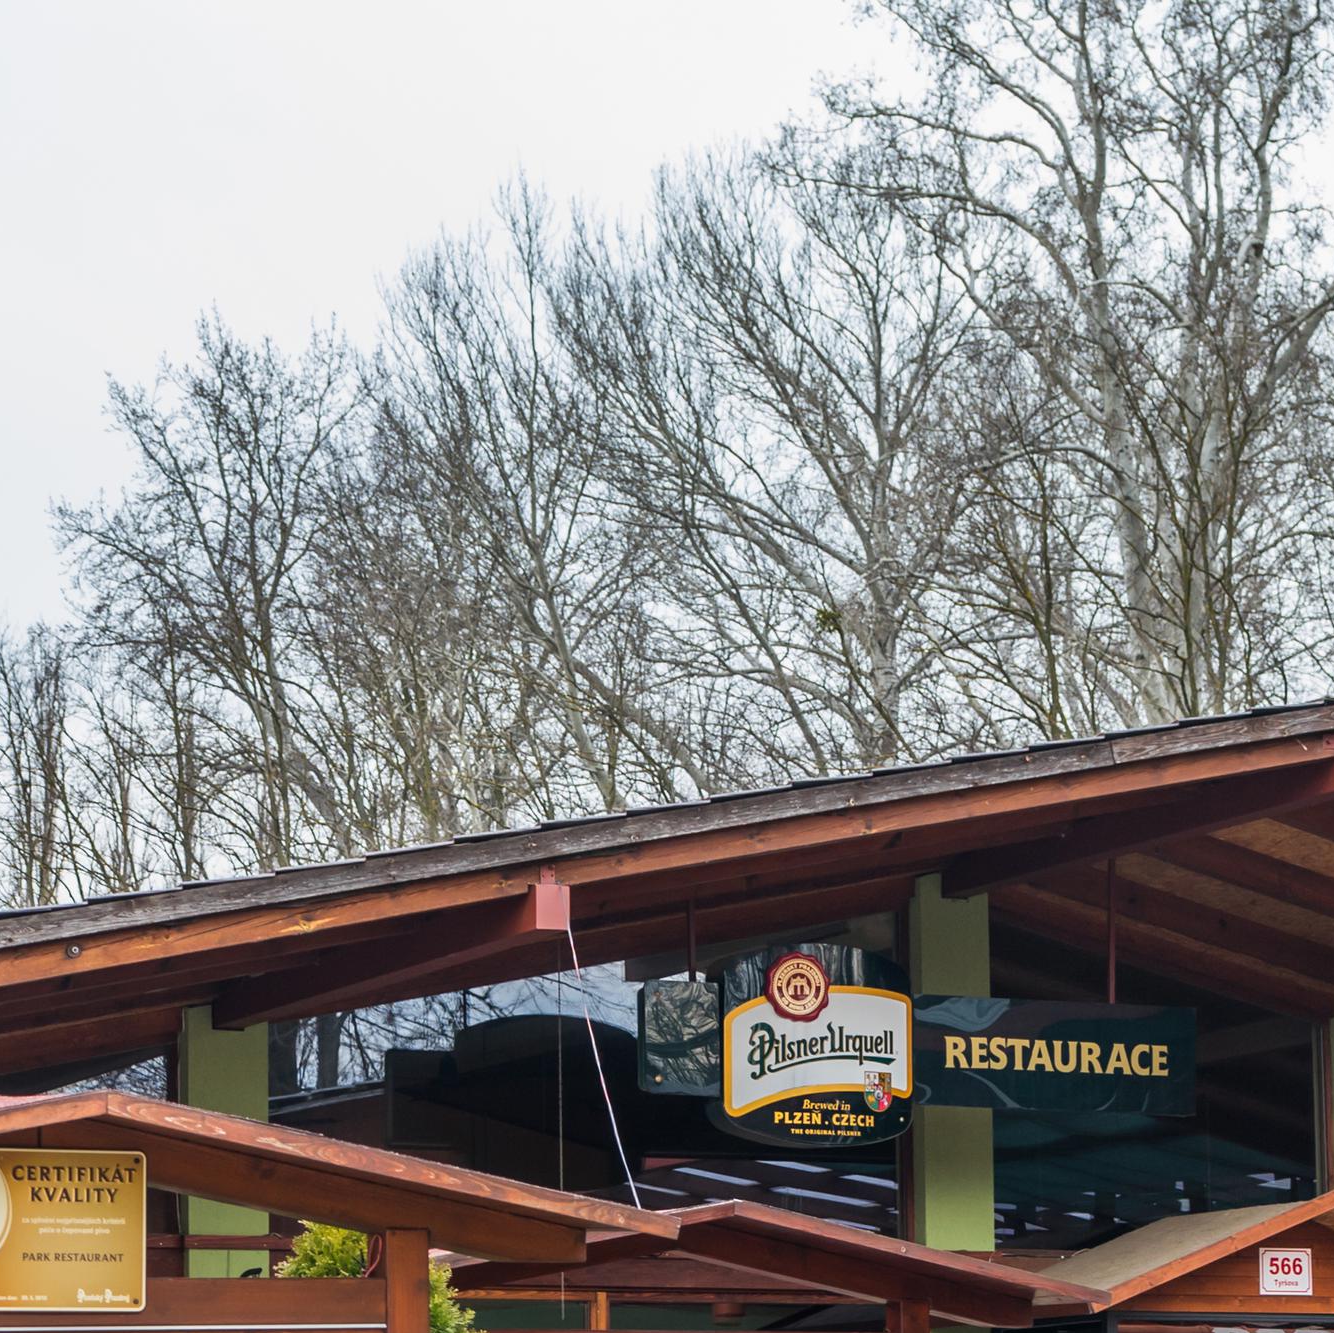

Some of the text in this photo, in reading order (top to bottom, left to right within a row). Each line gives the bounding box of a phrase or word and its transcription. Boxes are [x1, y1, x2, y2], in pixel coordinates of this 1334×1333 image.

[747, 1022, 894, 1080] Pilsner Urquell
[943, 1035, 1170, 1077] RESTAURACE
[802, 1099, 851, 1111] Brewed in
[773, 1109, 875, 1128] PLZEŇ CZECH
[790, 1128, 862, 1137] THE ORIGINAL PILSNER
[11, 1164, 137, 1183] CERTIFIKÁT
[30, 1186, 119, 1203] KVALITY
[22, 1252, 124, 1263] PARK RESTAURANT
[1269, 1257, 1303, 1275] 566
